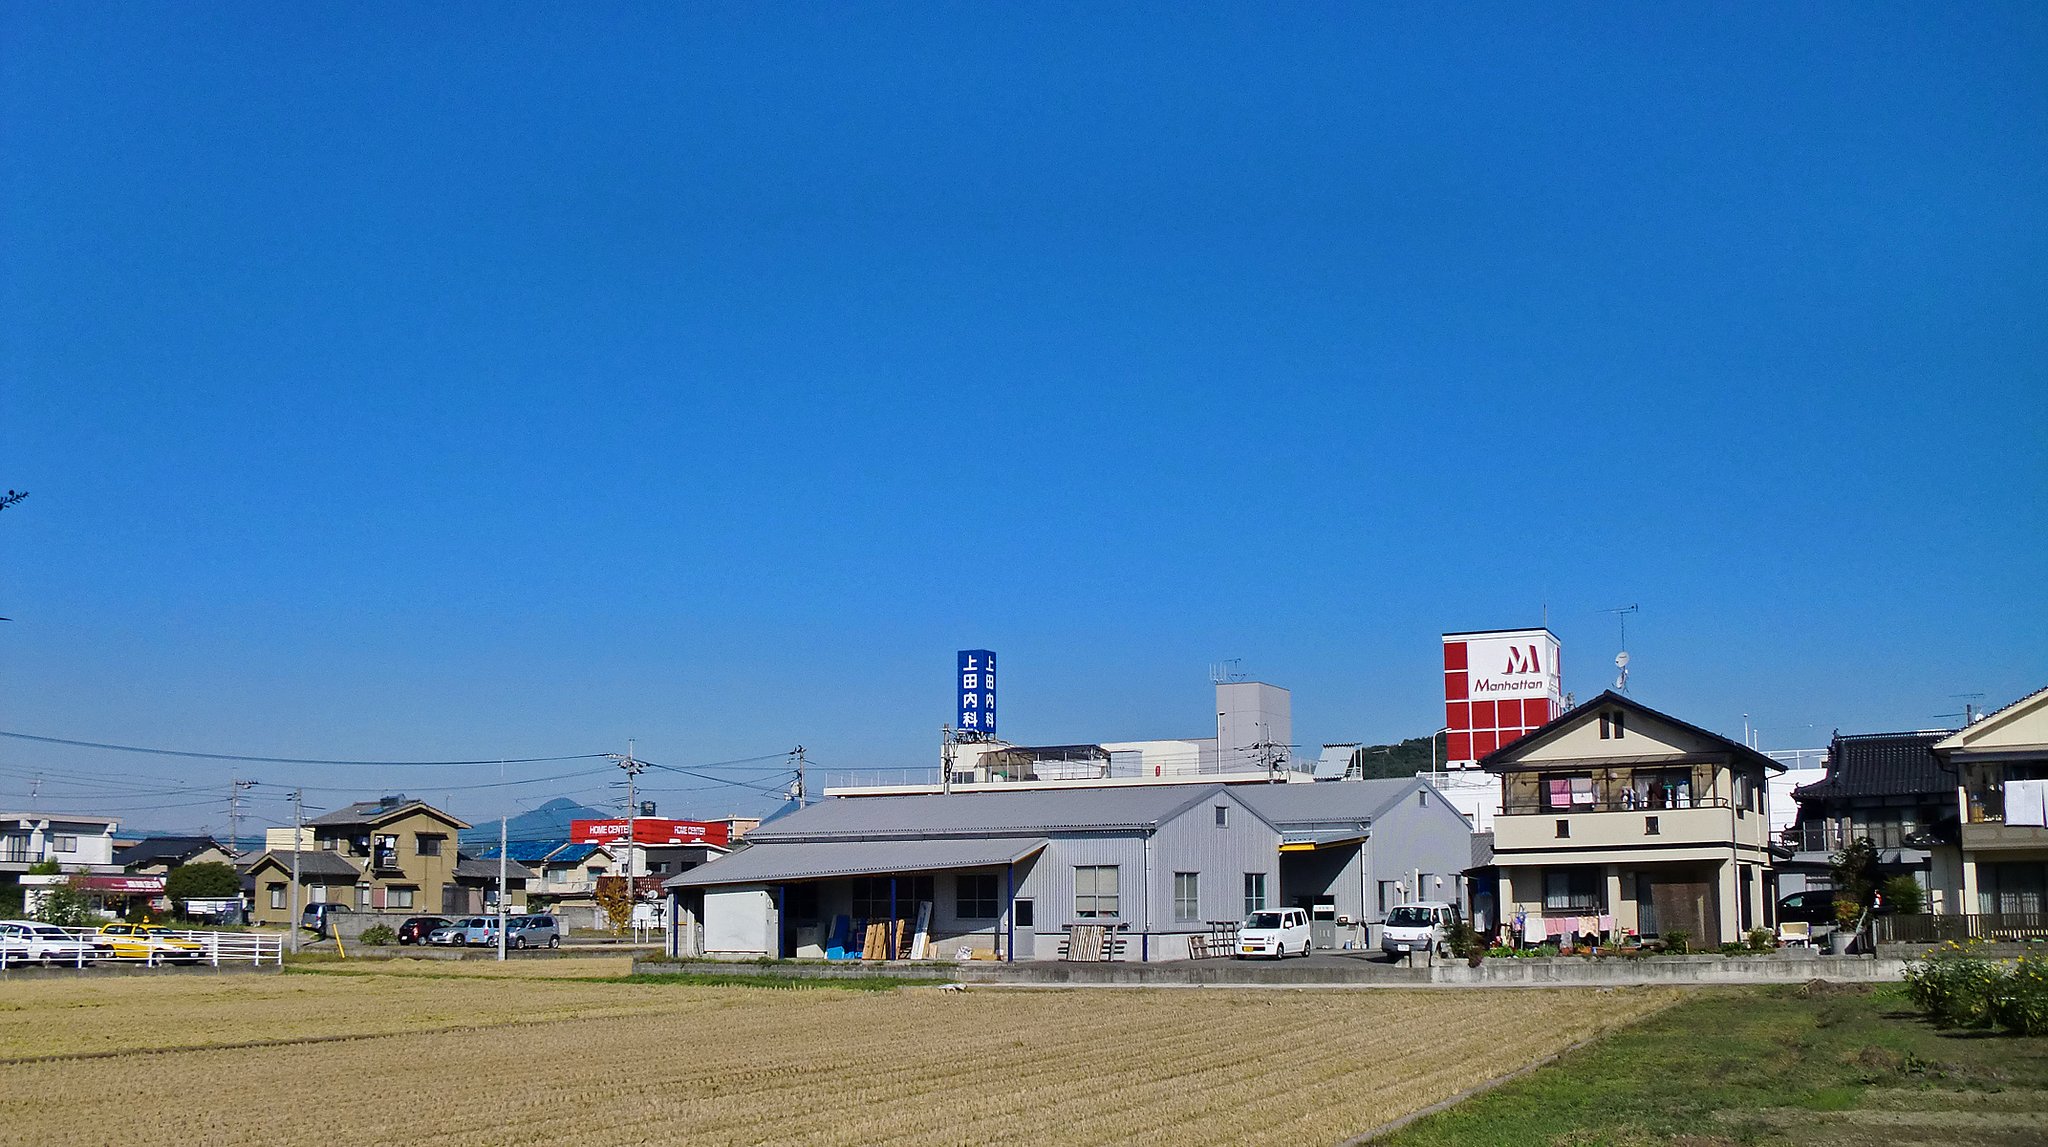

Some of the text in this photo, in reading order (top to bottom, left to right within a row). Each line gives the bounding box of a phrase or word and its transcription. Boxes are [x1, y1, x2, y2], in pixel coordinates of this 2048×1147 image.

[963, 654, 978, 728] 上田内科
[985, 655, 995, 729] 上田内科
[1474, 678, 1543, 693] Manhattan
[589, 825, 630, 834] HOME CENTE
[674, 825, 706, 836] HOME CENTER
